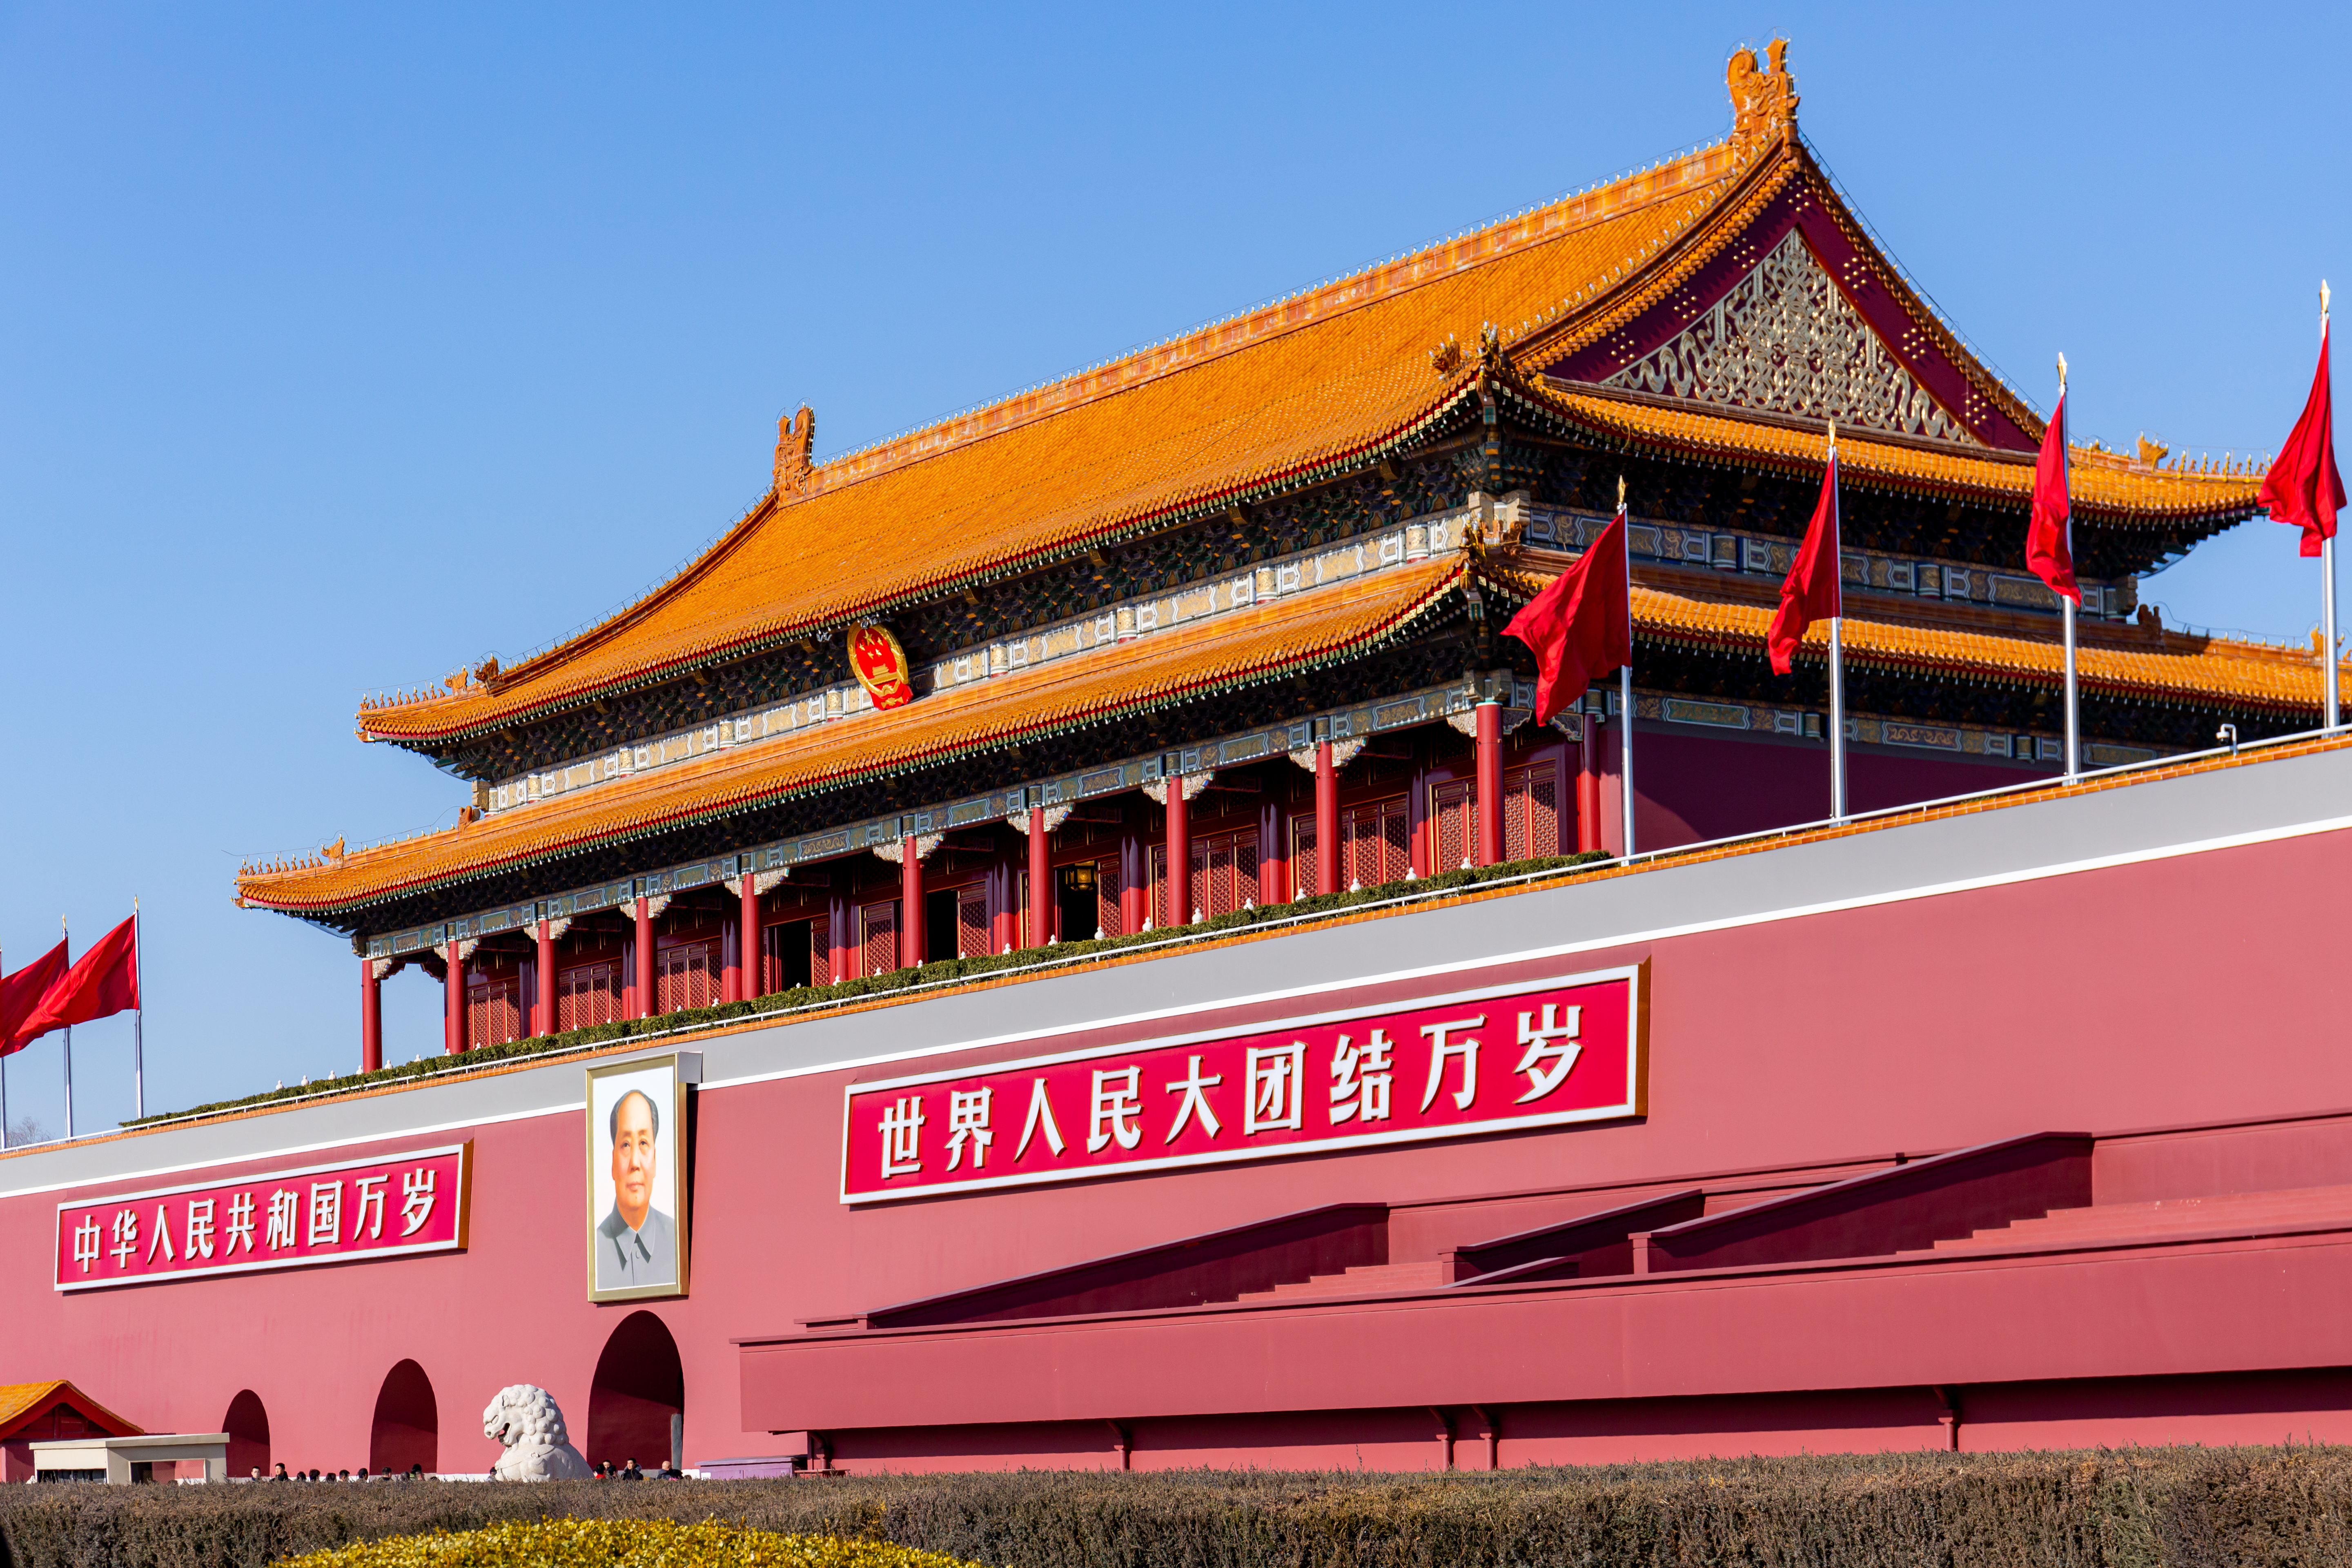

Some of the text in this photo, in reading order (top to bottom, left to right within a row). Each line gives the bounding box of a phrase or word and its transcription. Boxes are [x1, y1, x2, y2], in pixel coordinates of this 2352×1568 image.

[878, 1003, 1583, 1179] 世界人民大团结万岁
[74, 1167, 437, 1273] 中华人民共和国万岁
